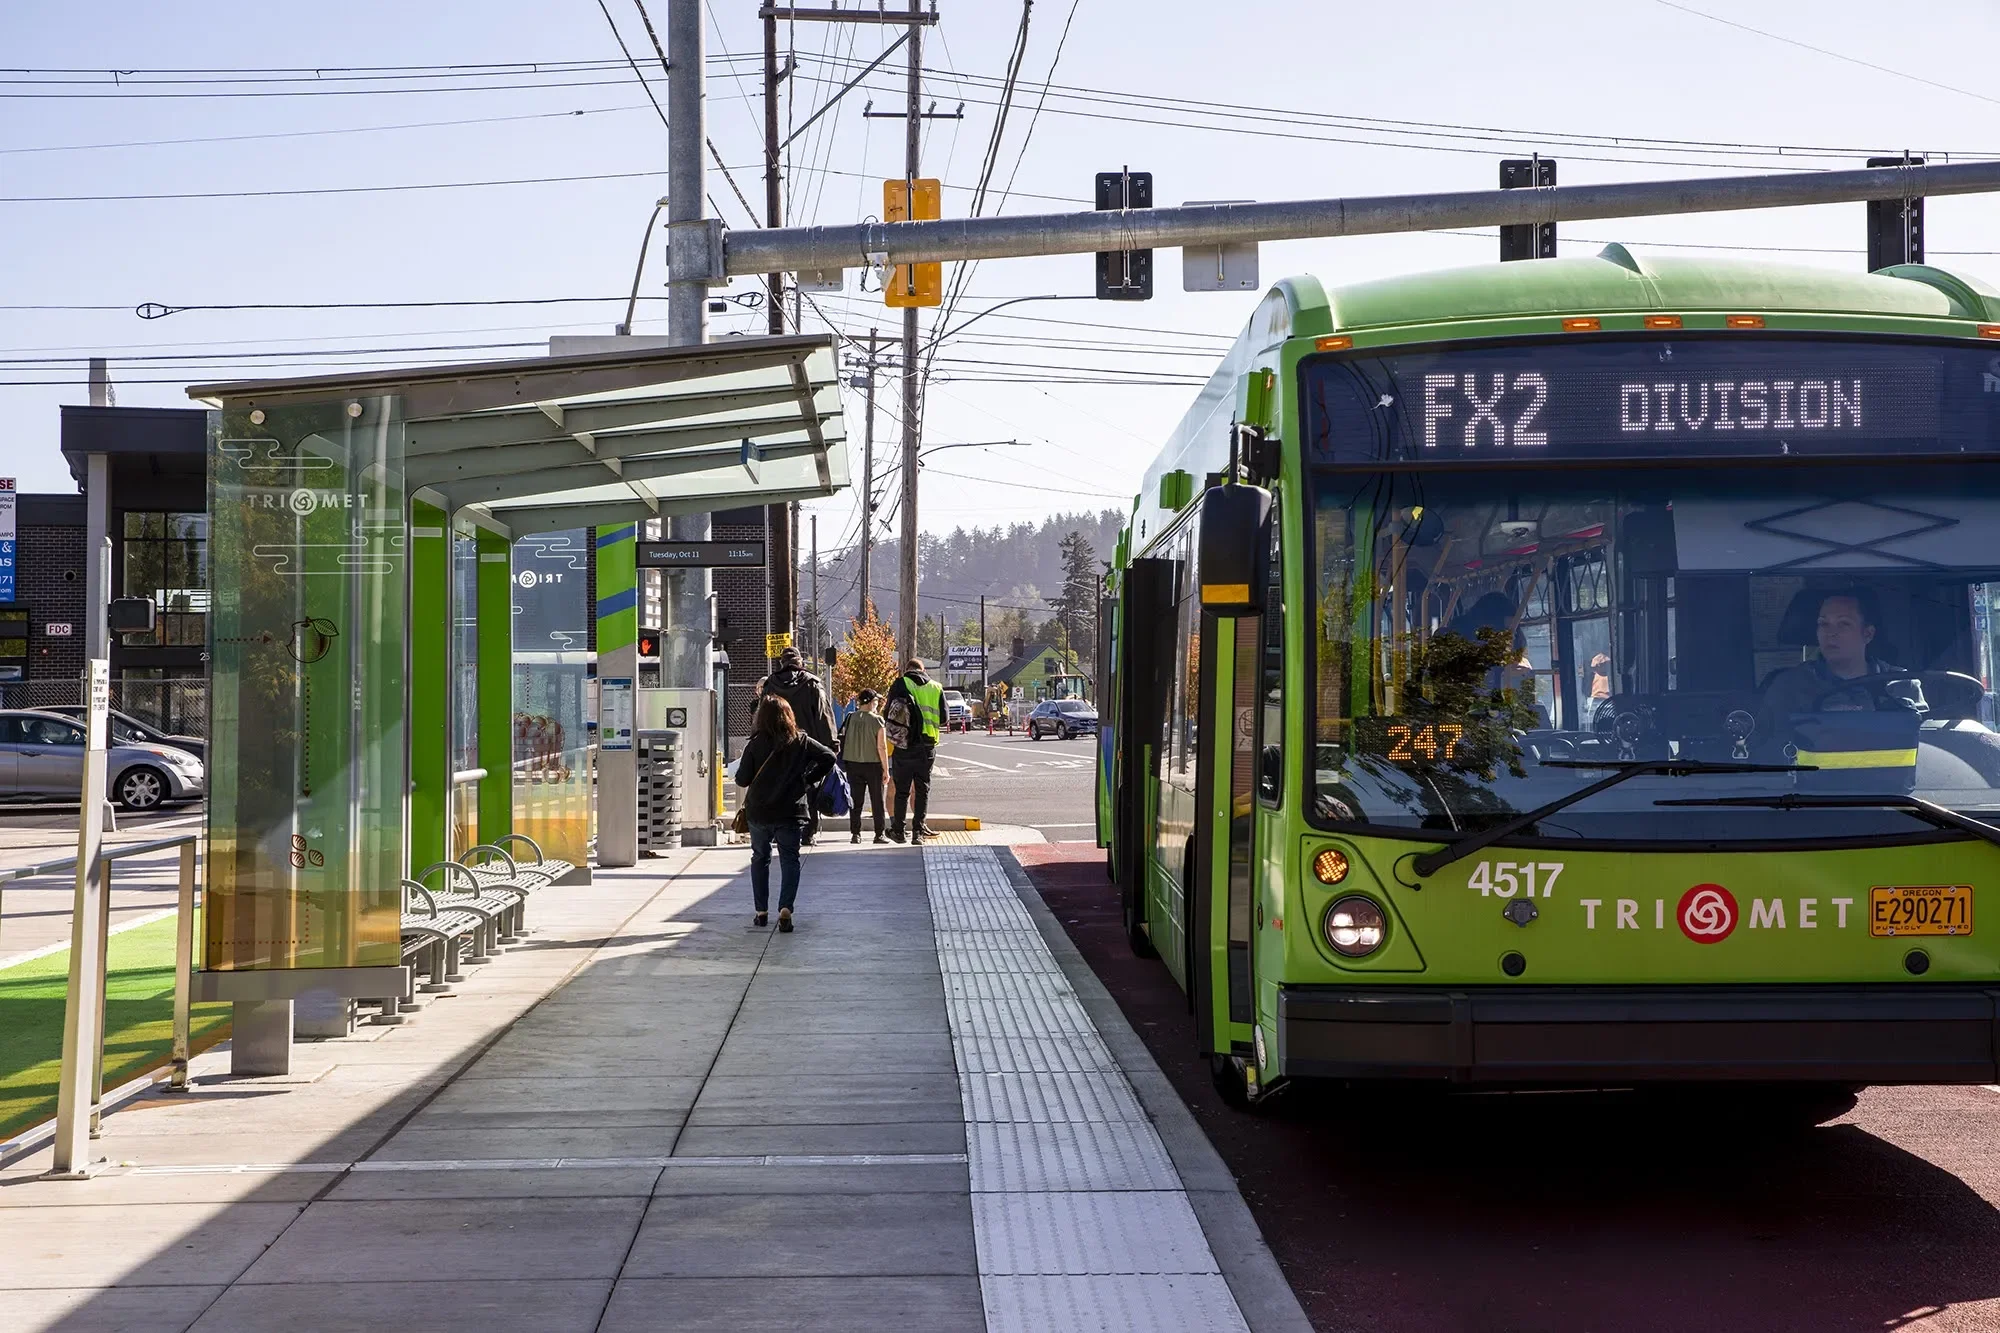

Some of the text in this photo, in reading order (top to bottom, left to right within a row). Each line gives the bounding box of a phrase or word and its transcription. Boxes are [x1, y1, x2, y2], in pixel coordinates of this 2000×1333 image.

[1425, 373, 1862, 447] FX2 DIVISION
[246, 493, 369, 509] TRI MET
[1, 541, 12, 553] &
[649, 551, 678, 560] Tuesday,
[49, 624, 69, 634] FDC
[1387, 724, 1463, 760] 247
[1467, 861, 1565, 898] 4517
[1902, 889, 1942, 897] OREGON
[1579, 898, 1854, 930] TRI MET
[1875, 896, 1966, 925] E290271
